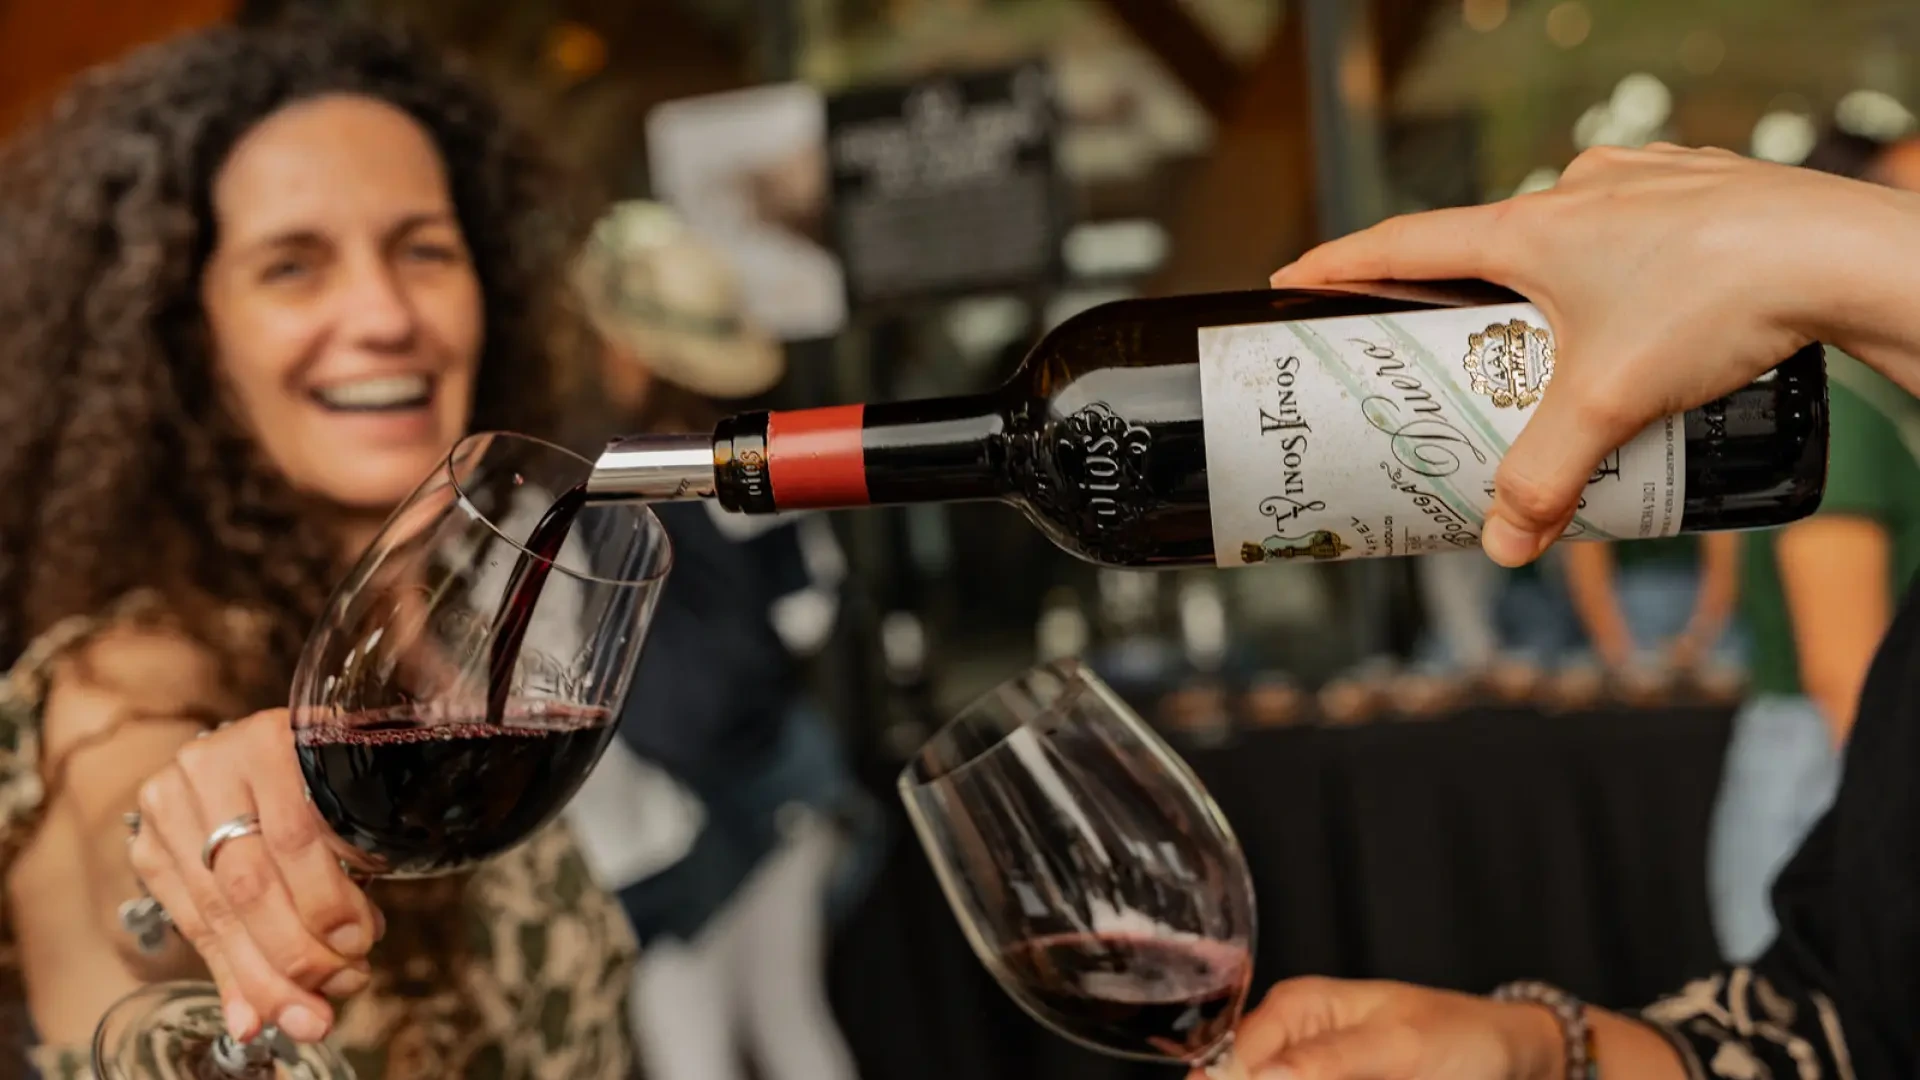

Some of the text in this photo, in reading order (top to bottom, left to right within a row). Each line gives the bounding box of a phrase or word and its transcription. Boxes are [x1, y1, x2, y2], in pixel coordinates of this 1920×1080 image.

[1259, 355, 1326, 532] VINOS FINOS
[1344, 337, 1486, 477] Duero
